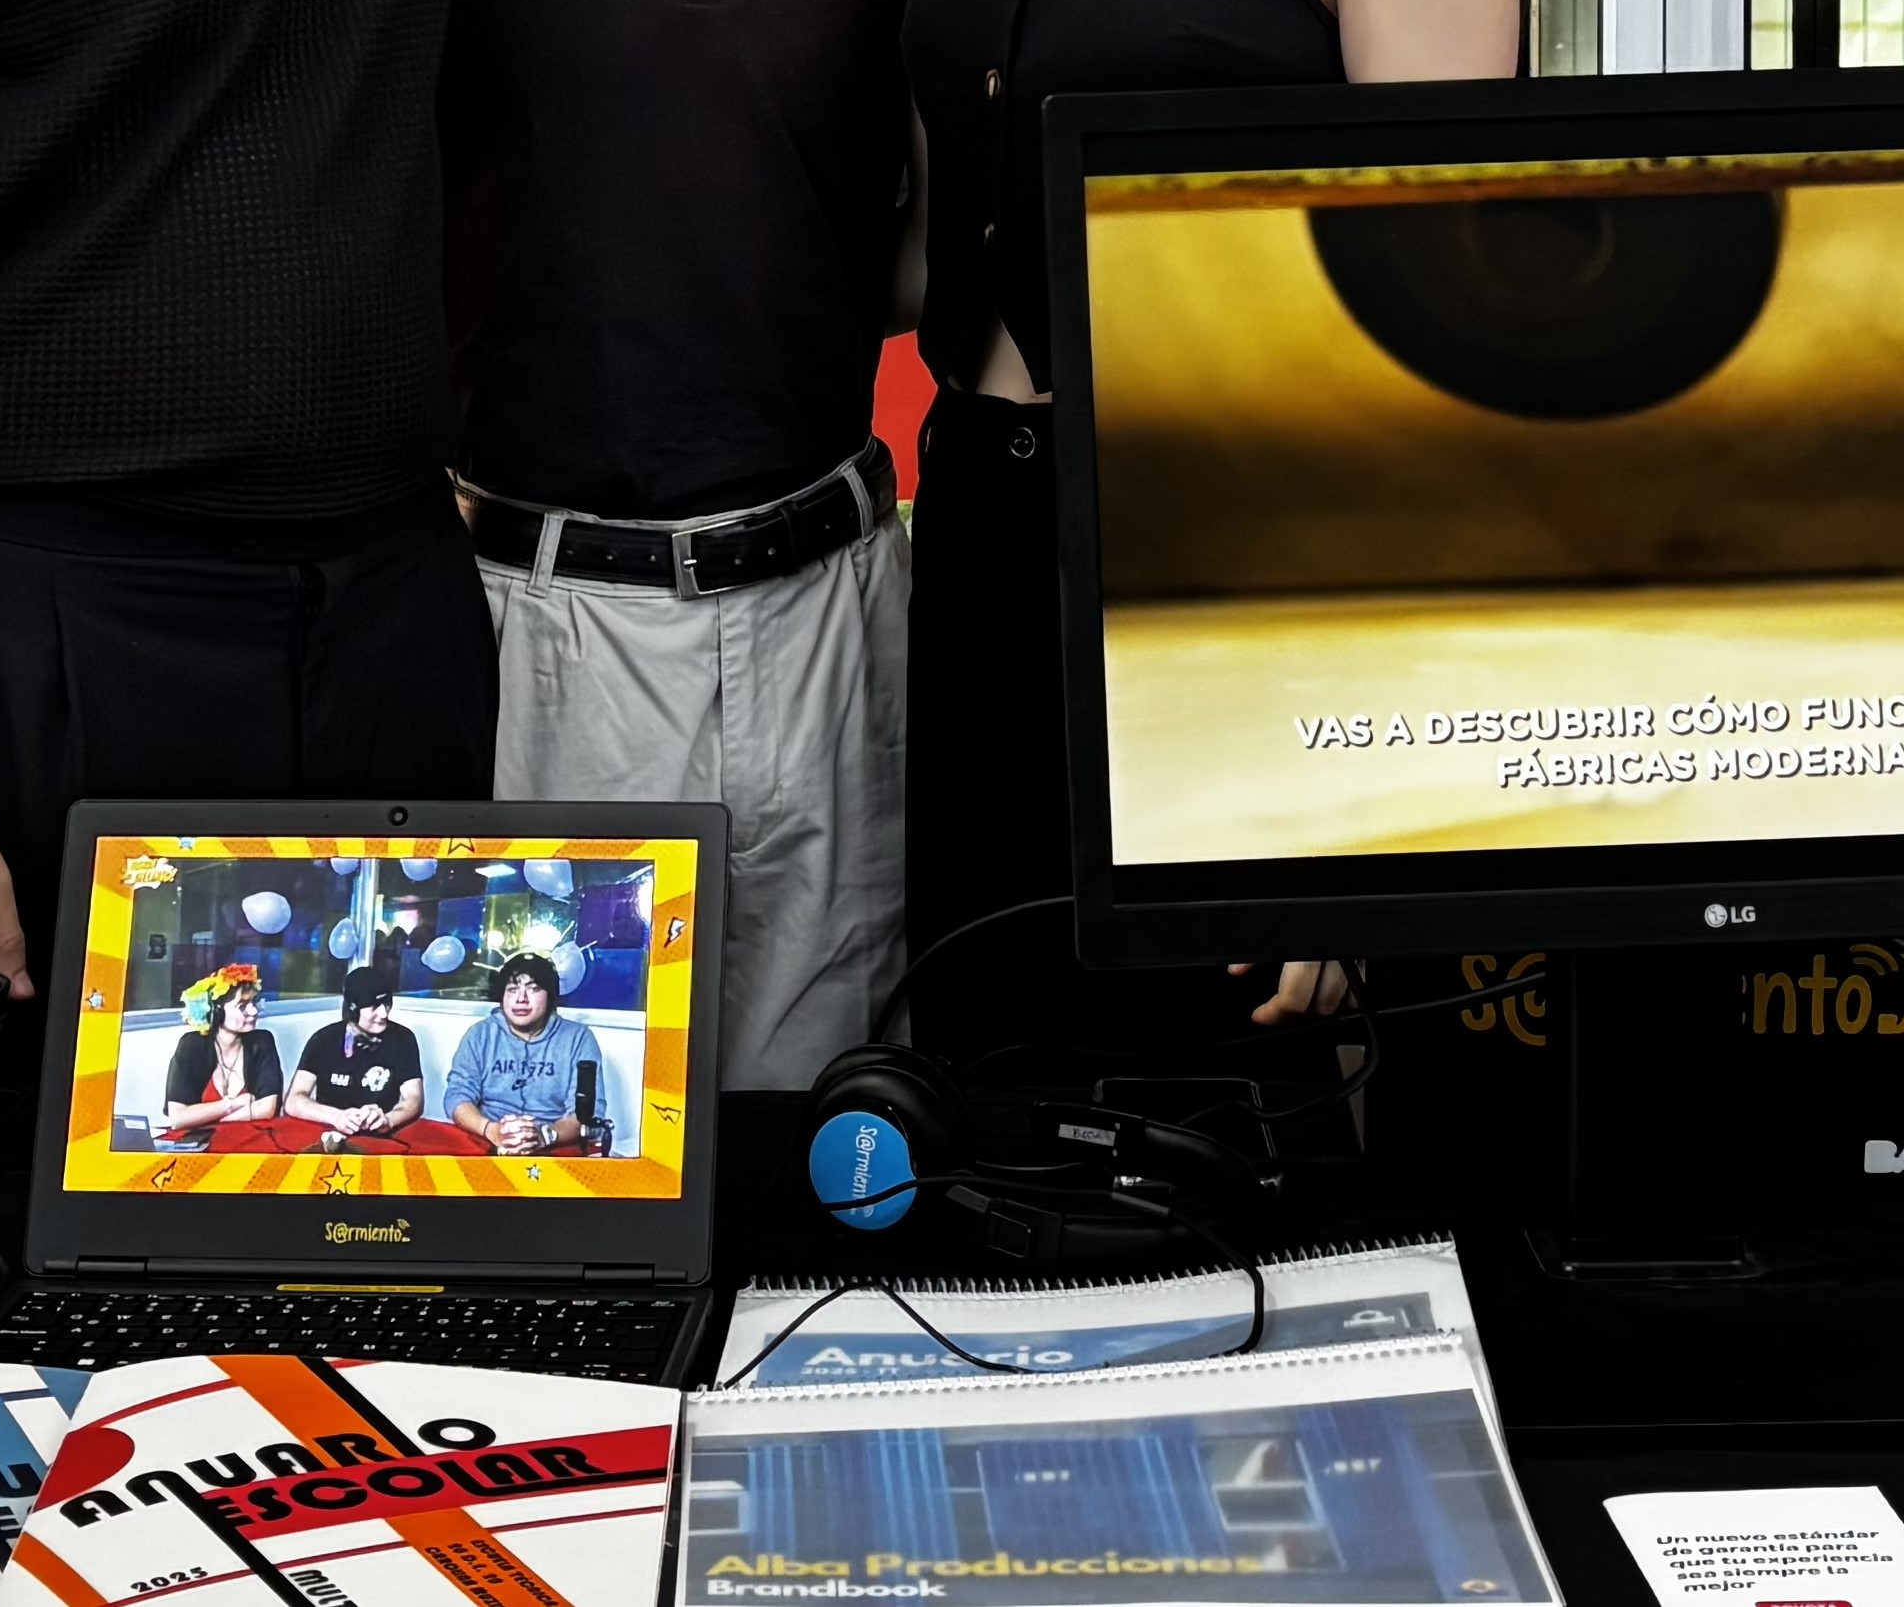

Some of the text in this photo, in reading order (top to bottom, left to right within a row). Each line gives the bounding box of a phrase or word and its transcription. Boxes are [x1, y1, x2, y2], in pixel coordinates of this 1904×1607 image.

[1296, 715, 1375, 751] VAS
[1384, 711, 1414, 743] A
[1425, 703, 1656, 744] DESCUBRIR
[1664, 694, 1795, 737] CÓMO
[1497, 748, 1697, 788] FÁBRICAS
[1730, 905, 1756, 925] LG
[325, 1222, 402, 1244] S@rmiento
[59, 1417, 497, 1528] ANUARIO
[200, 1446, 607, 1530] ESCOLAR
[1657, 1530, 1880, 1545] Un nuevo estándar
[1663, 1543, 1859, 1557] de garantía para
[705, 1552, 1263, 1577] Alba Producciones
[1669, 1553, 1894, 1570] que tu experiencia
[131, 1566, 209, 1594] 2025
[1677, 1565, 1849, 1581] sea siempre la
[707, 1579, 948, 1599] Brandbook
[1683, 1580, 1756, 1593] mejor
